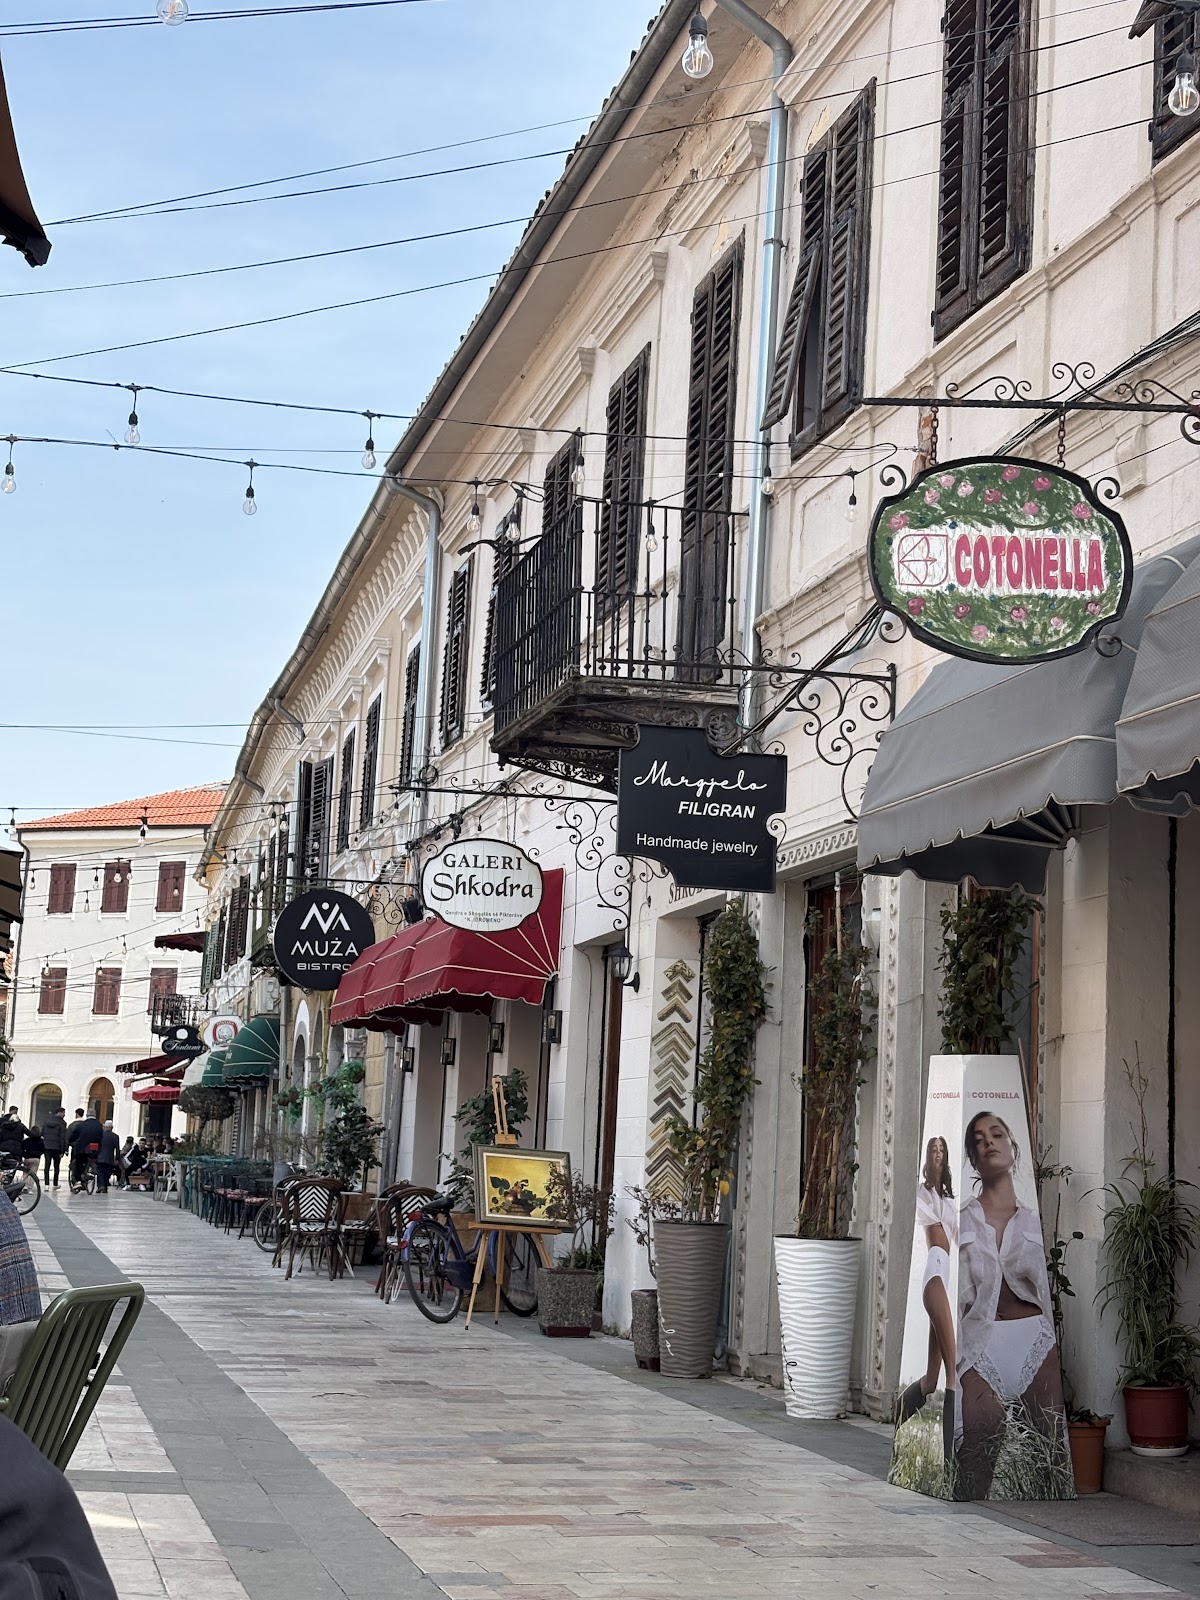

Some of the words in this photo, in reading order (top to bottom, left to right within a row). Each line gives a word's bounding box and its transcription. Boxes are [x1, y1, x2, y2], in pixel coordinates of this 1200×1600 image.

[955, 533, 1104, 591] COTONELLA
[633, 759, 768, 798] Margjelo
[678, 801, 756, 819] FILIGRAN
[636, 833, 709, 851] Handmade
[711, 839, 758, 857] jewelry
[443, 853, 523, 871] GALERI
[430, 872, 535, 902] Shkodra
[290, 937, 359, 957] MUŻA
[297, 962, 352, 971] BISTRO
[932, 1091, 961, 1099] COTONELLA
[971, 1091, 1020, 1099] COTONELLA
